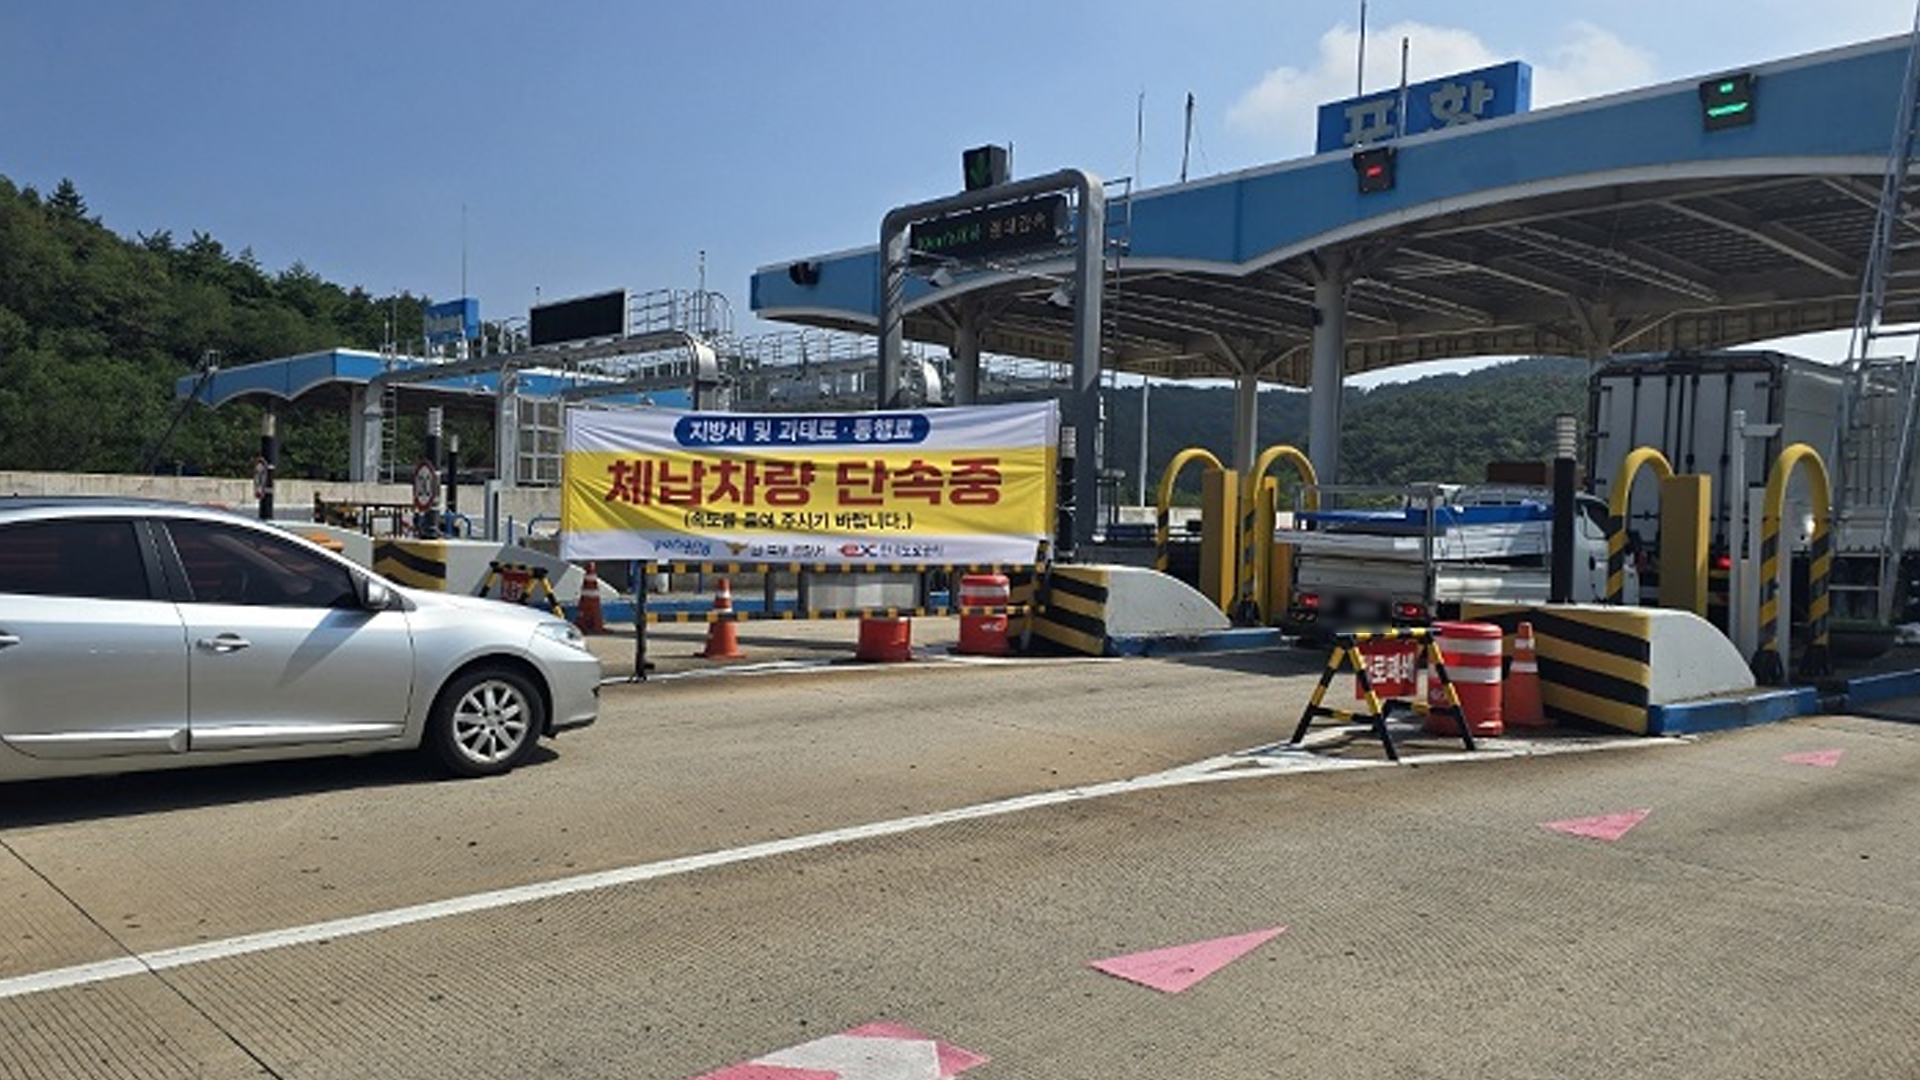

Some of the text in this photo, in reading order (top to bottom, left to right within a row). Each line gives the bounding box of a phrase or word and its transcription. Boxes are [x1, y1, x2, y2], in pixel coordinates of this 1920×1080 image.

[690, 418, 914, 442] 지방세 및 과태료 통행료
[605, 457, 1003, 506] 체납차량 단속중
[781, 512, 829, 530] 주시기
[836, 512, 913, 530] 바랍니다.)
[1366, 652, 1415, 684] 로폐쇄
